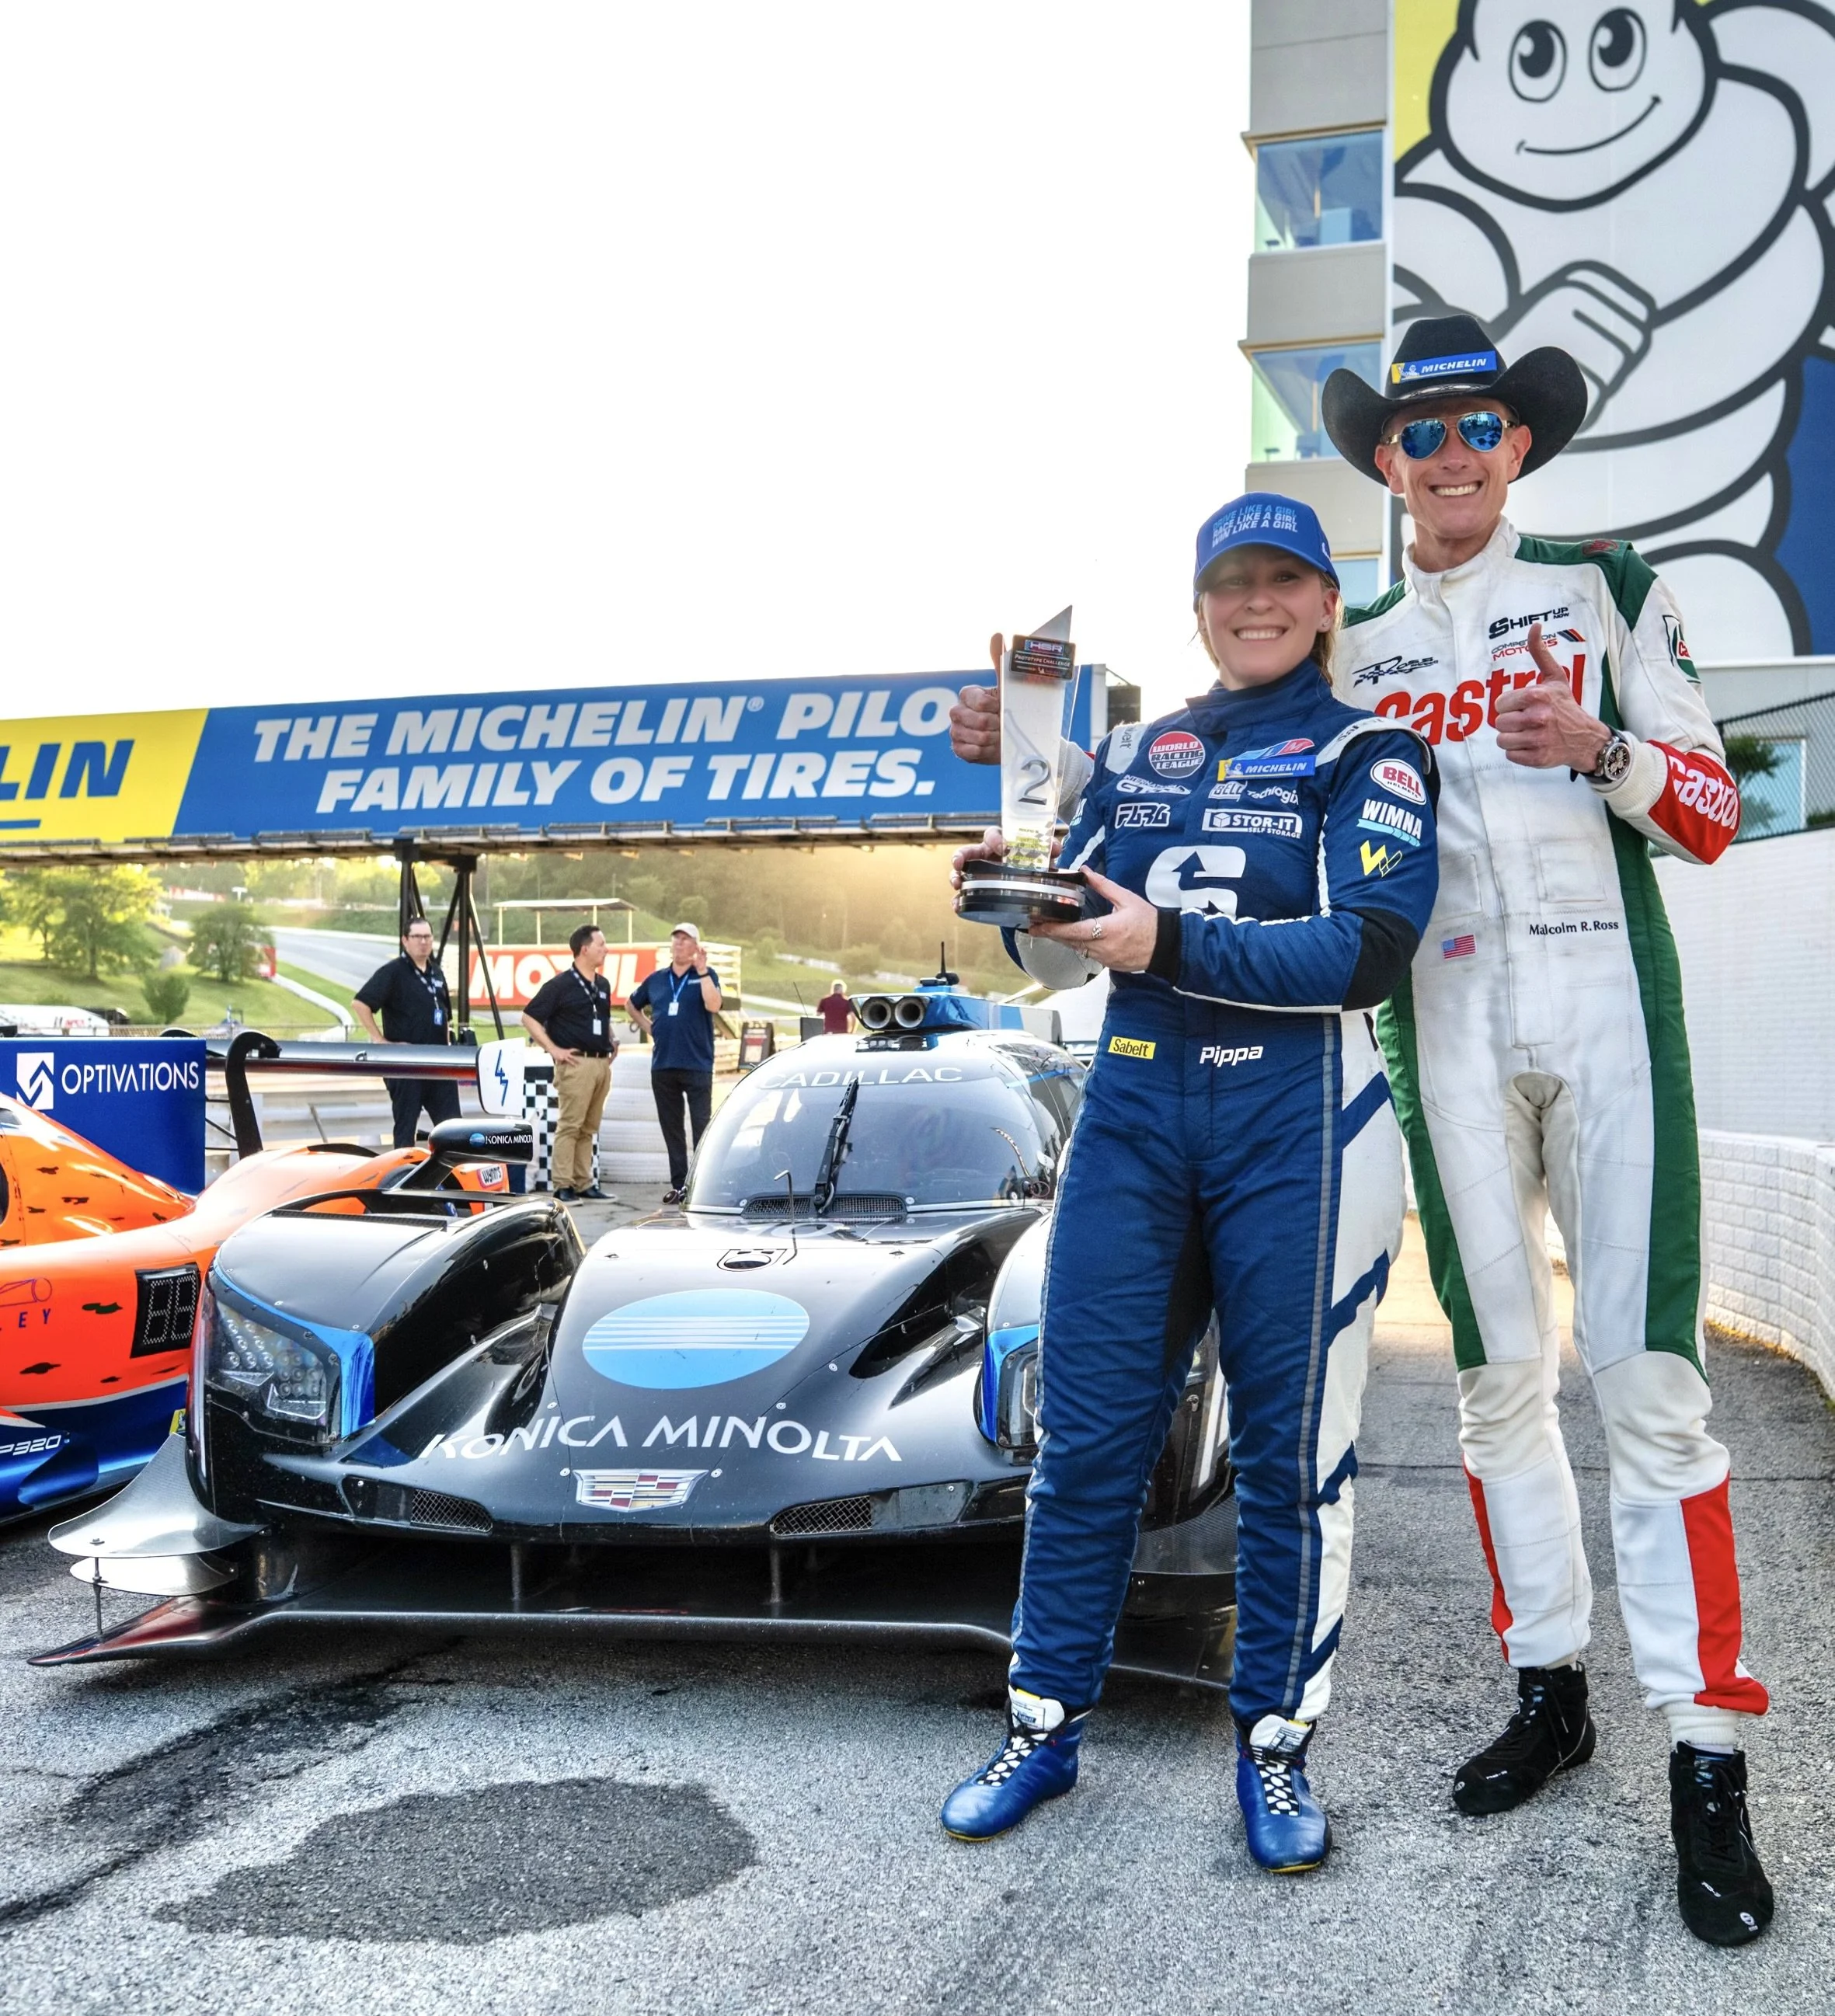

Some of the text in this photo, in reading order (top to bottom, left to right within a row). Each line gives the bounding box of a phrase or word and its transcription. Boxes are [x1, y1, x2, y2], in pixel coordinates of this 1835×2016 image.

[1421, 357, 1487, 373] MICHELIN
[1239, 504, 1262, 516] LIKE
[1275, 506, 1297, 517] GIRL
[1212, 528, 1231, 548] WIN
[1232, 520, 1259, 534] LIKE
[1273, 521, 1298, 533] GIRL
[1213, 519, 1234, 539] RACE
[1237, 512, 1261, 524] LIKE
[1274, 513, 1297, 524] GIRL
[1553, 607, 1569, 615] UP
[254, 713, 379, 763] THE
[775, 687, 954, 740] PILO
[1152, 741, 1198, 752] WORLD
[1155, 758, 1202, 770] LEAGUE
[1245, 762, 1307, 773] MICHELIN
[315, 748, 937, 814] FAMILY OF TIRES.
[1018, 759, 1049, 805] 2
[1383, 766, 1422, 796] BELL
[1232, 814, 1294, 830] STOR-IT
[1362, 799, 1422, 840] WIMNA
[1267, 827, 1301, 839] STORAGE
[1529, 920, 1619, 935] Malcolm R. Ross
[1113, 1038, 1149, 1057] Sabelt
[1199, 1046, 1264, 1067] Pippa
[61, 1060, 200, 1095] OPTIVATIONS
[761, 1067, 963, 1088] CADILLAC
[486, 1135, 513, 1144] KONICA
[419, 1415, 904, 1462] KONICA MINOLTA
